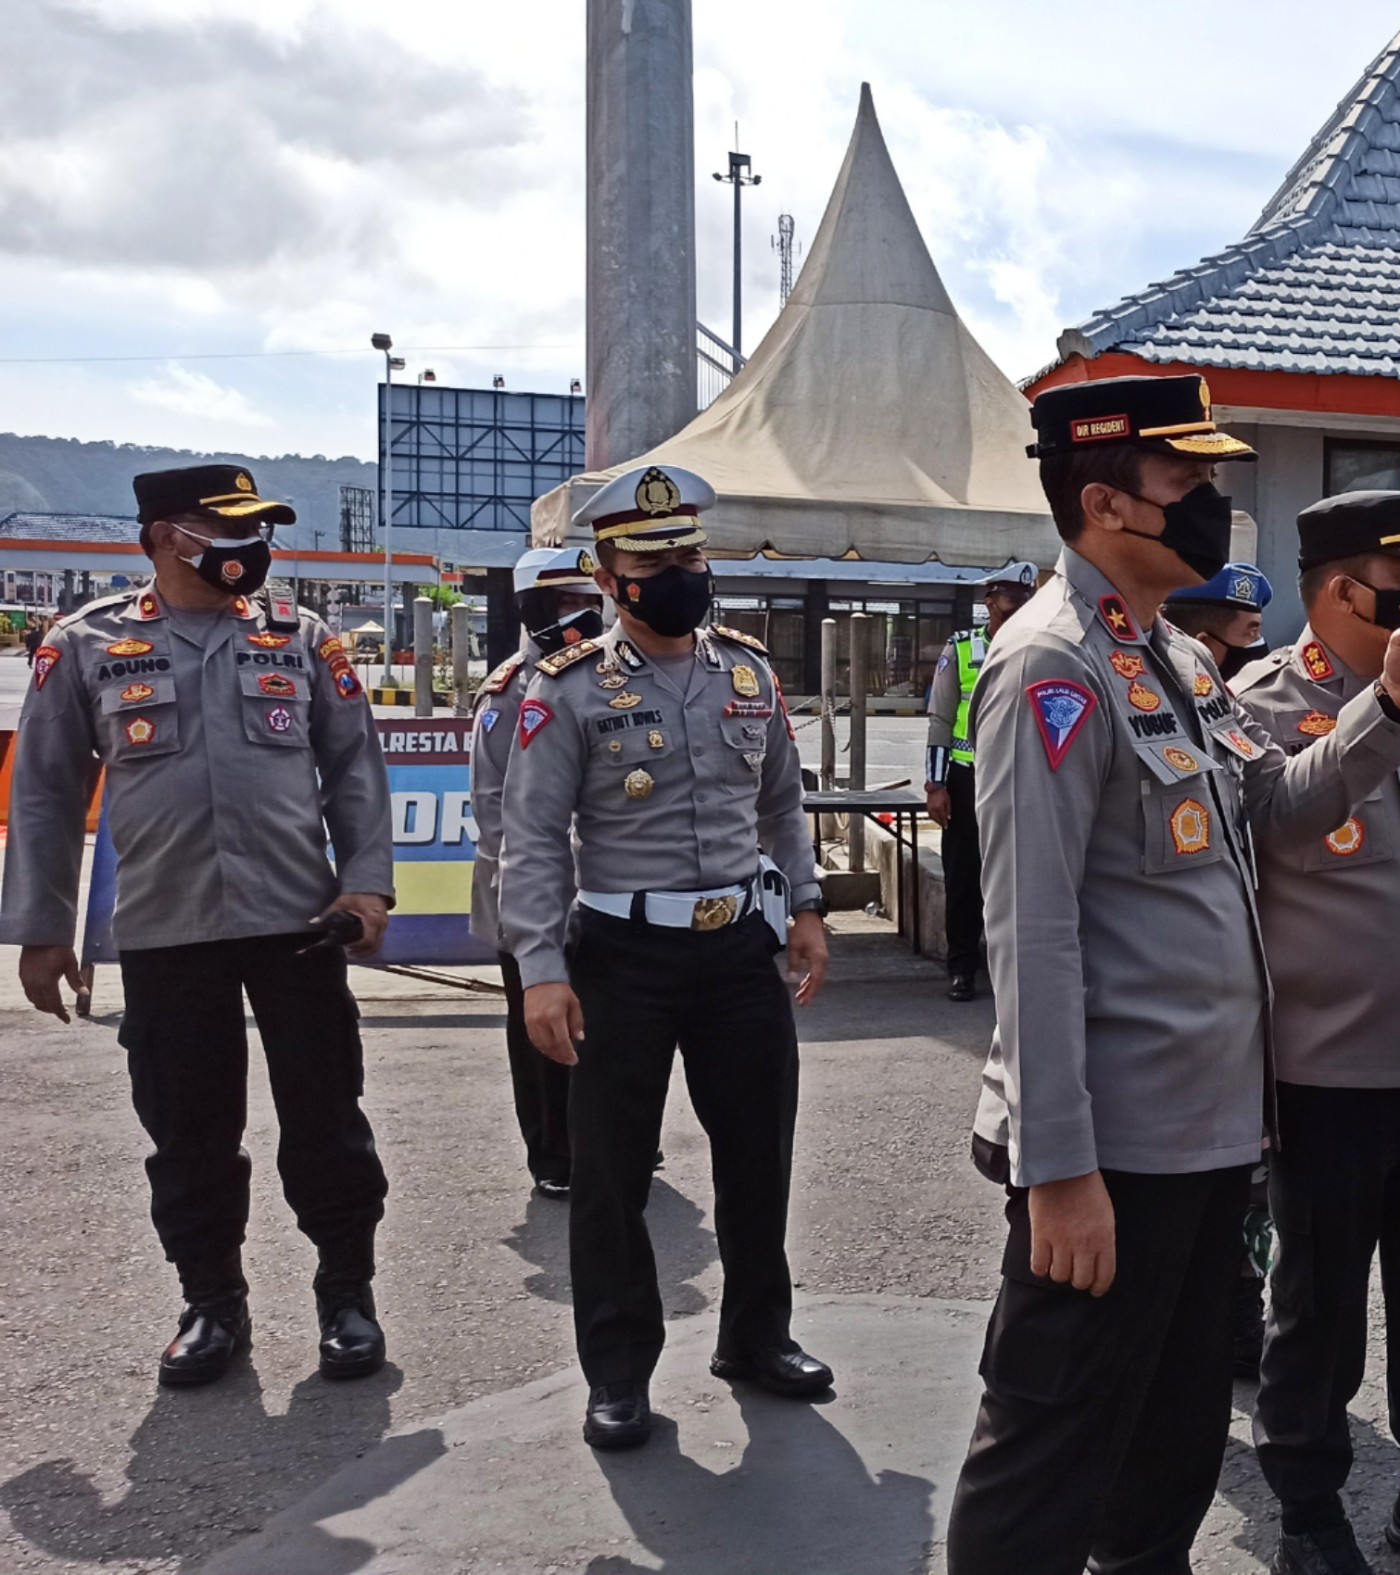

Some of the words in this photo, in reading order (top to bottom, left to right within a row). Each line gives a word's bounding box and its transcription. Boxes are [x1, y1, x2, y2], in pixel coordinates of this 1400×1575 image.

[97, 657, 171, 681] AGUNG
[237, 652, 304, 669] POLRI
[1128, 712, 1177, 738] YUSUF
